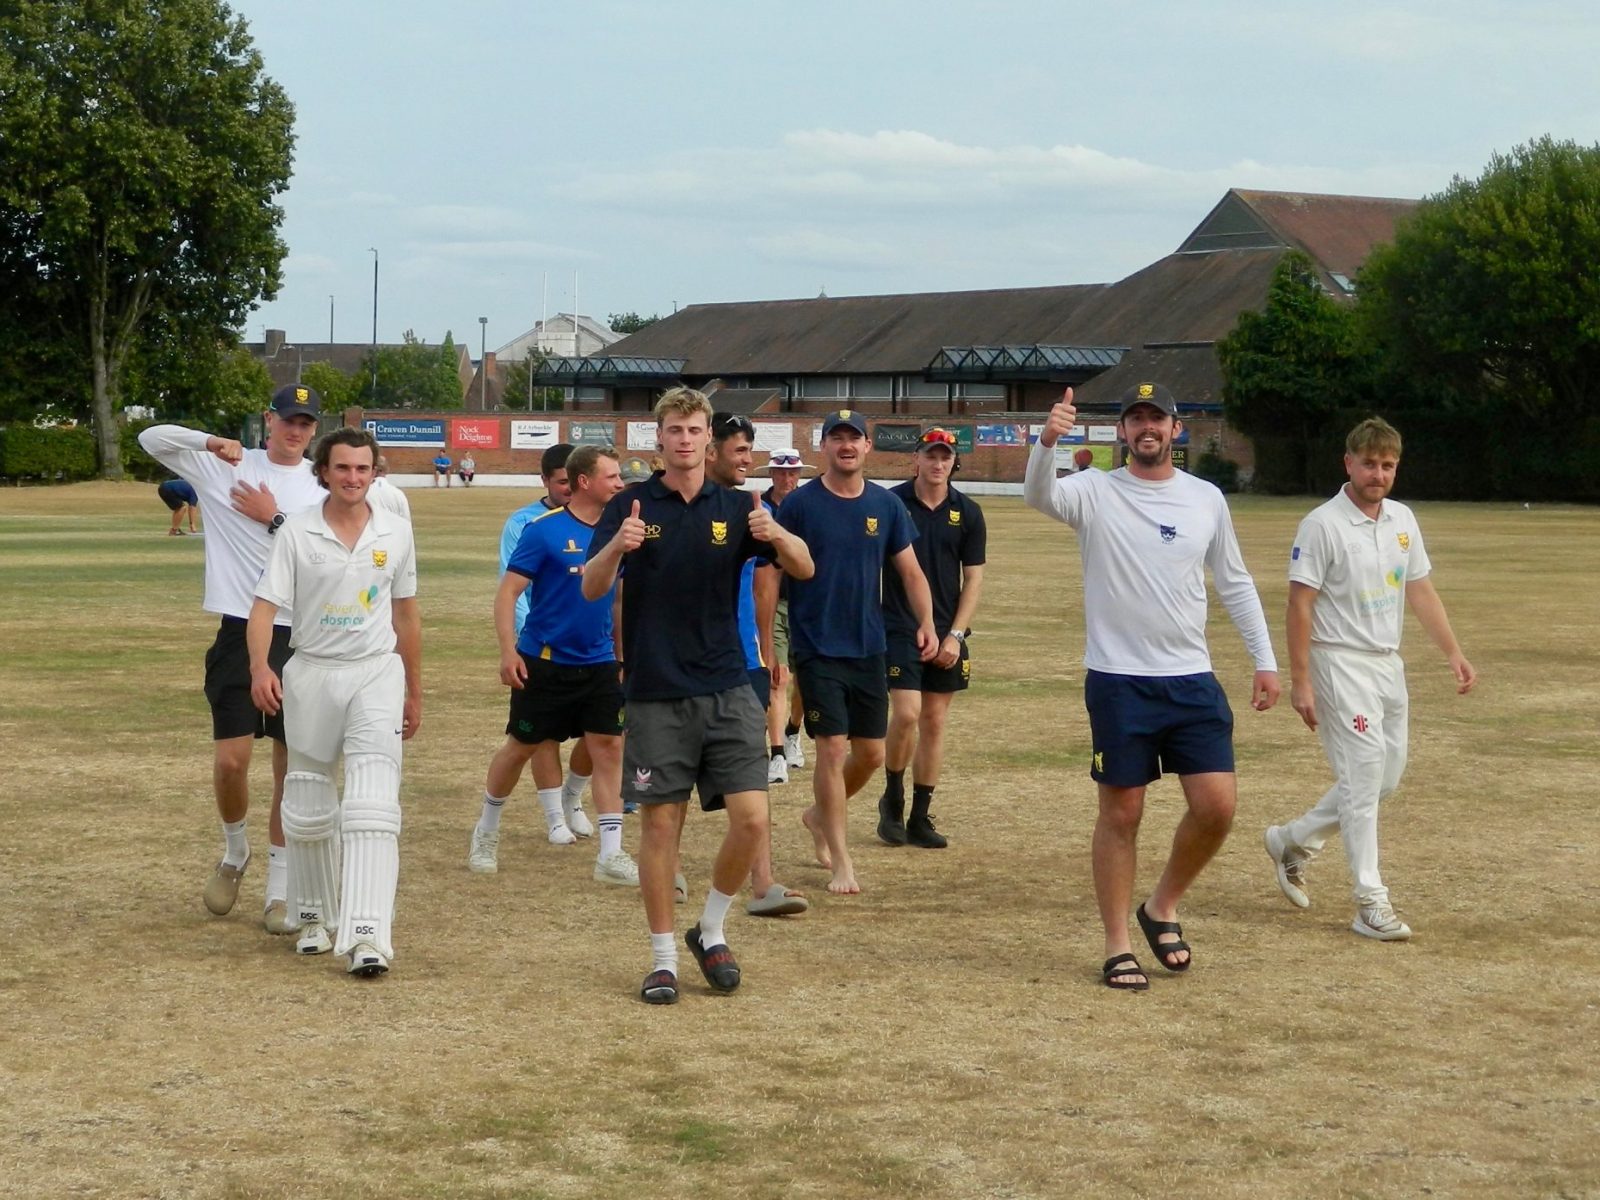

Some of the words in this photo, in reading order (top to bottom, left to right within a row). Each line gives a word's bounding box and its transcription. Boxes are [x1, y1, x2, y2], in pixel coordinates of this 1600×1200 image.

[377, 425, 407, 433] Craven
[409, 425, 441, 434] Dunnill
[459, 425, 479, 435] Nock
[459, 433, 493, 442] Deighton
[320, 614, 364, 627] Hospice
[300, 912, 318, 920] DSC
[355, 926, 374, 935] DSC
